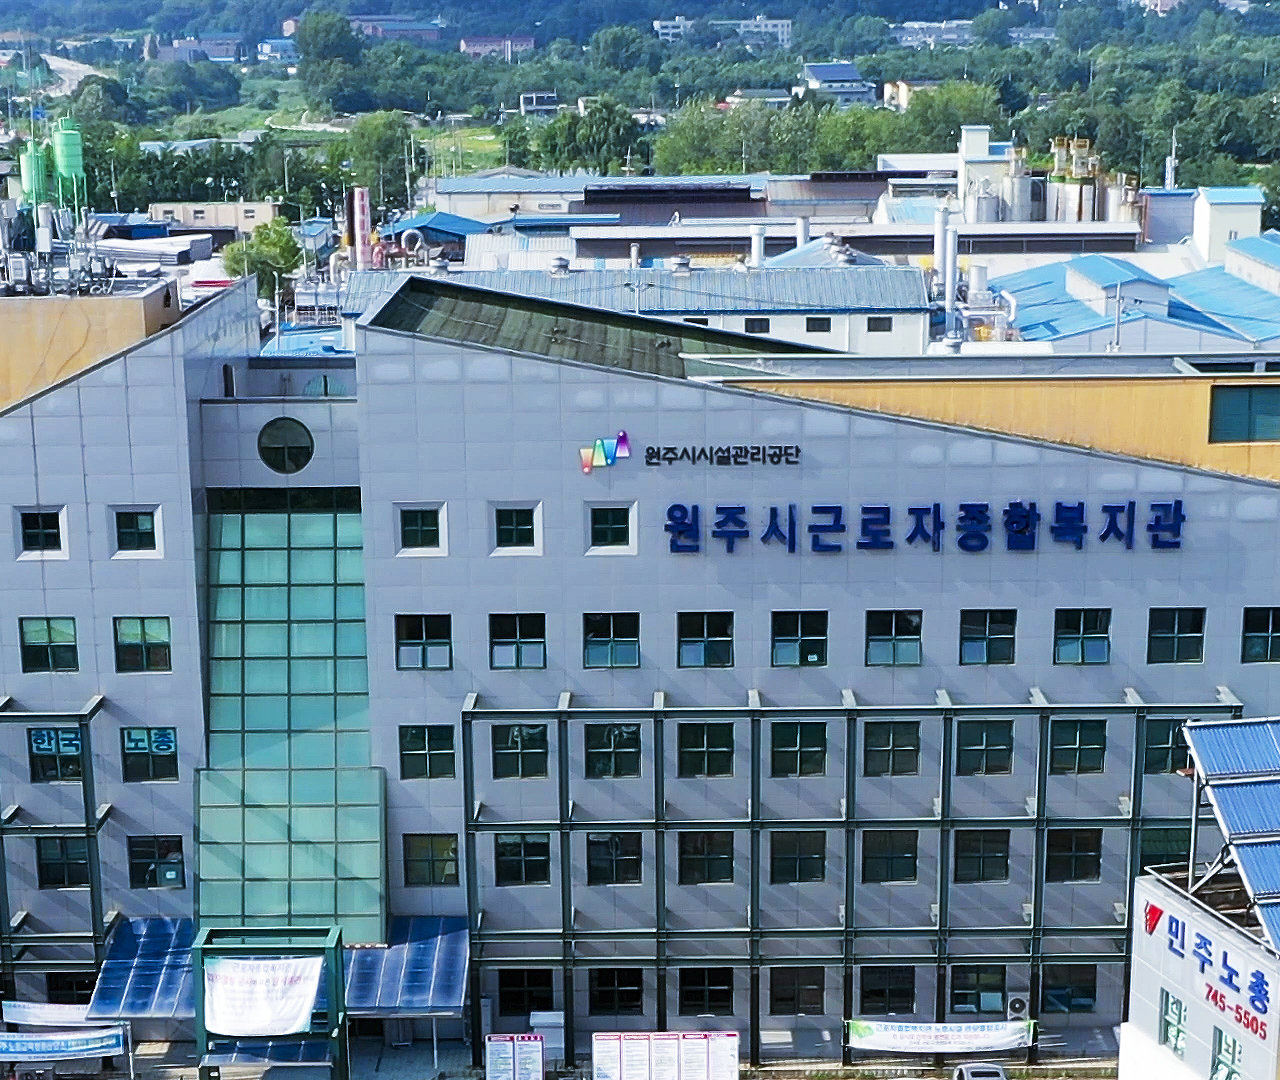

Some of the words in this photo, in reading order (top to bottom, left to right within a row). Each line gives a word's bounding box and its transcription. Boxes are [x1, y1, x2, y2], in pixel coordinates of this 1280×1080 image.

[644, 444, 802, 467] 원주시시설관리공단
[663, 499, 1187, 554] 원주시근로자종합복지관
[1167, 914, 1271, 1016] 민주노총
[1204, 982, 1268, 1041] 745-5505
